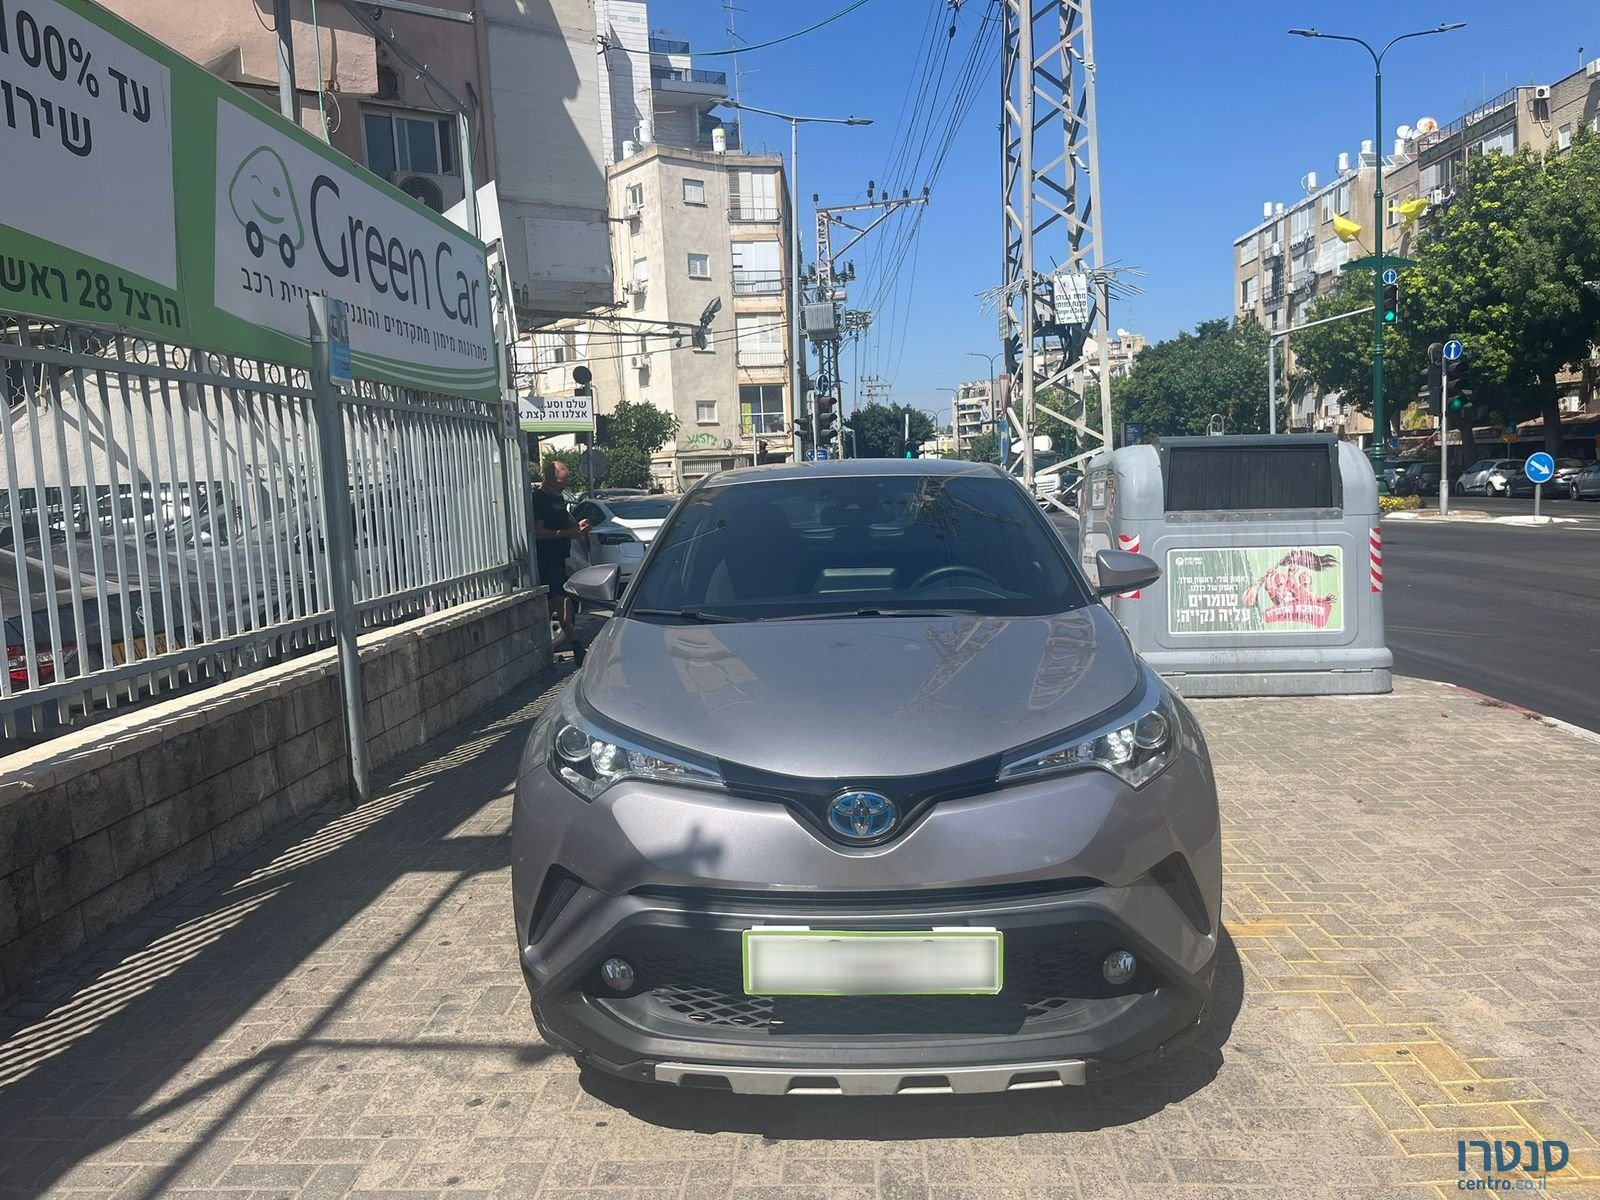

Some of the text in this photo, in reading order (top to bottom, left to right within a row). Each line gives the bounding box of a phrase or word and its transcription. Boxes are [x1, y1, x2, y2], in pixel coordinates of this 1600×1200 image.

[107, 66, 151, 124] עד
[309, 174, 480, 329] Green Car
[75, 268, 113, 312] 28
[241, 266, 274, 298] רכב
[118, 276, 181, 328] הרצל
[345, 302, 380, 329] והוגני
[383, 314, 431, 345] מתקדמים
[432, 330, 456, 352] מימון
[457, 338, 488, 361] פתרונות
[526, 410, 546, 420] קצת
[548, 410, 559, 419] זה
[562, 409, 588, 418] אצלנו
[566, 399, 587, 409] שלם
[1188, 593, 1239, 607] שומרים
[1176, 609, 1215, 624] נקייה!
[1218, 606, 1251, 622] עליה
